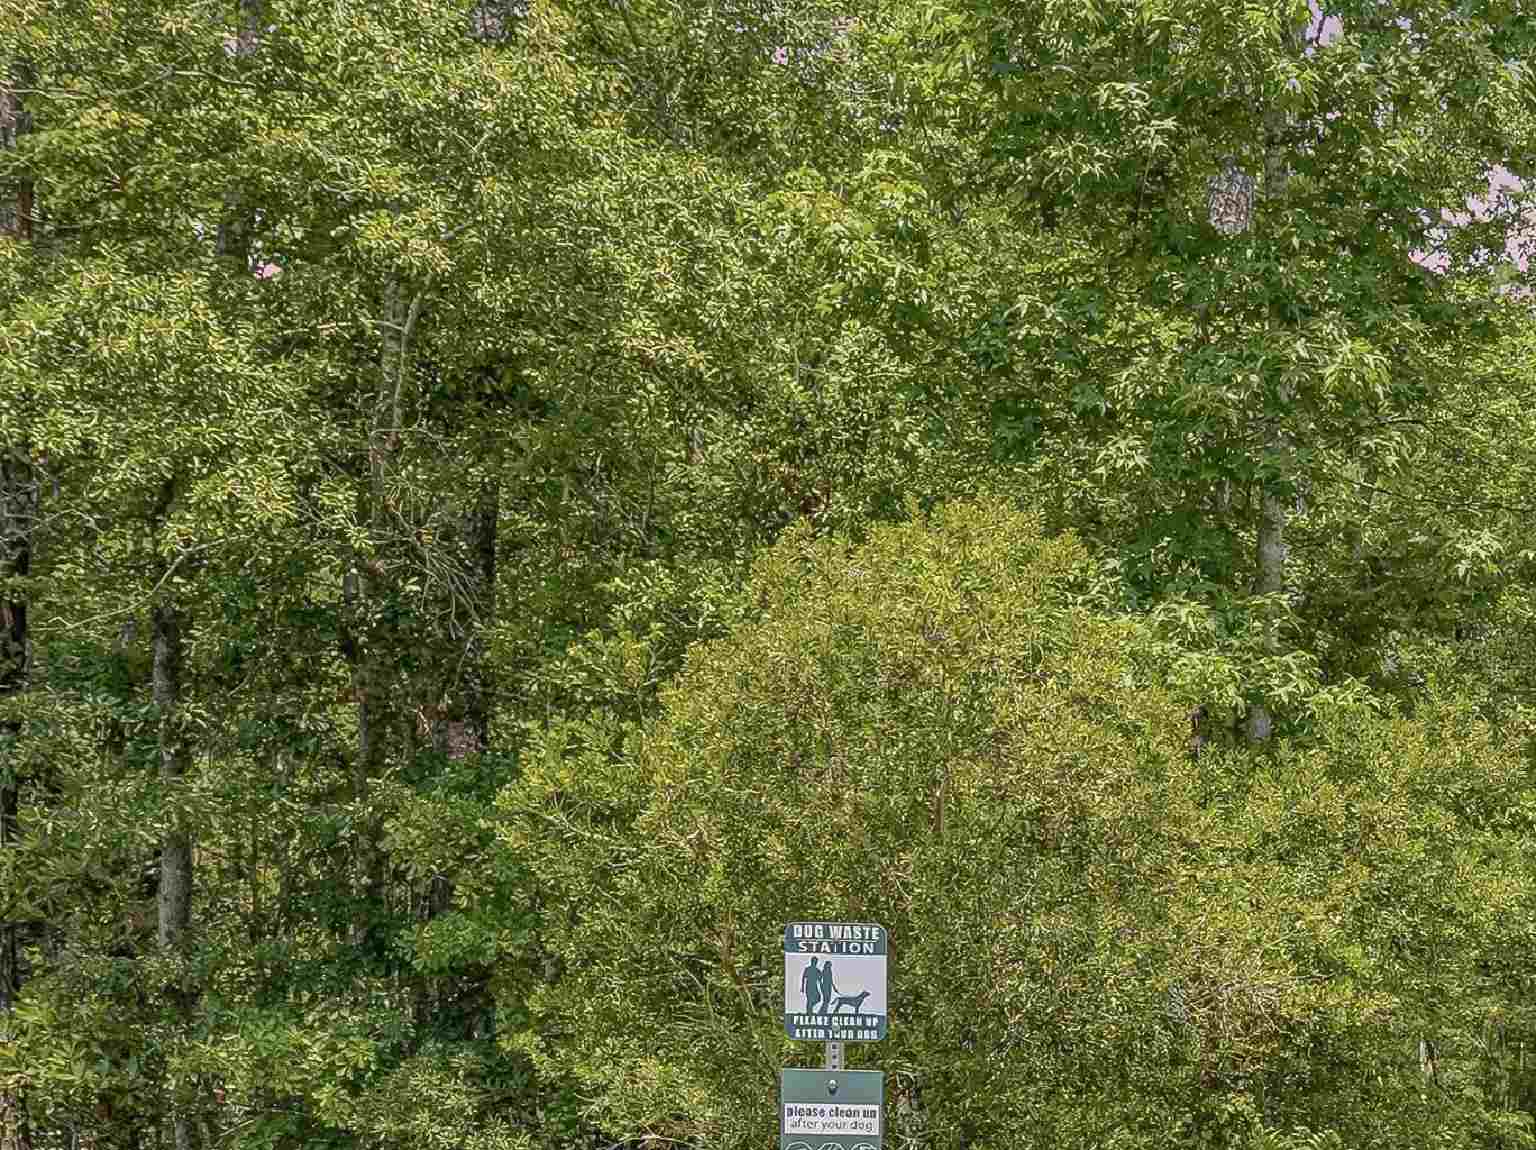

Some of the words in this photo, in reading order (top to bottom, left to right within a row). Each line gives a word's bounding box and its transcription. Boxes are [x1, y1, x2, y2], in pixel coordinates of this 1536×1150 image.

[793, 924, 824, 938] DOG
[829, 925, 880, 940] WASTE
[799, 941, 874, 953] STATION
[786, 1103, 825, 1118] please
[829, 1106, 860, 1119] clean
[790, 1118, 817, 1129] after
[821, 1120, 848, 1131] your
[850, 1119, 873, 1132] dog
